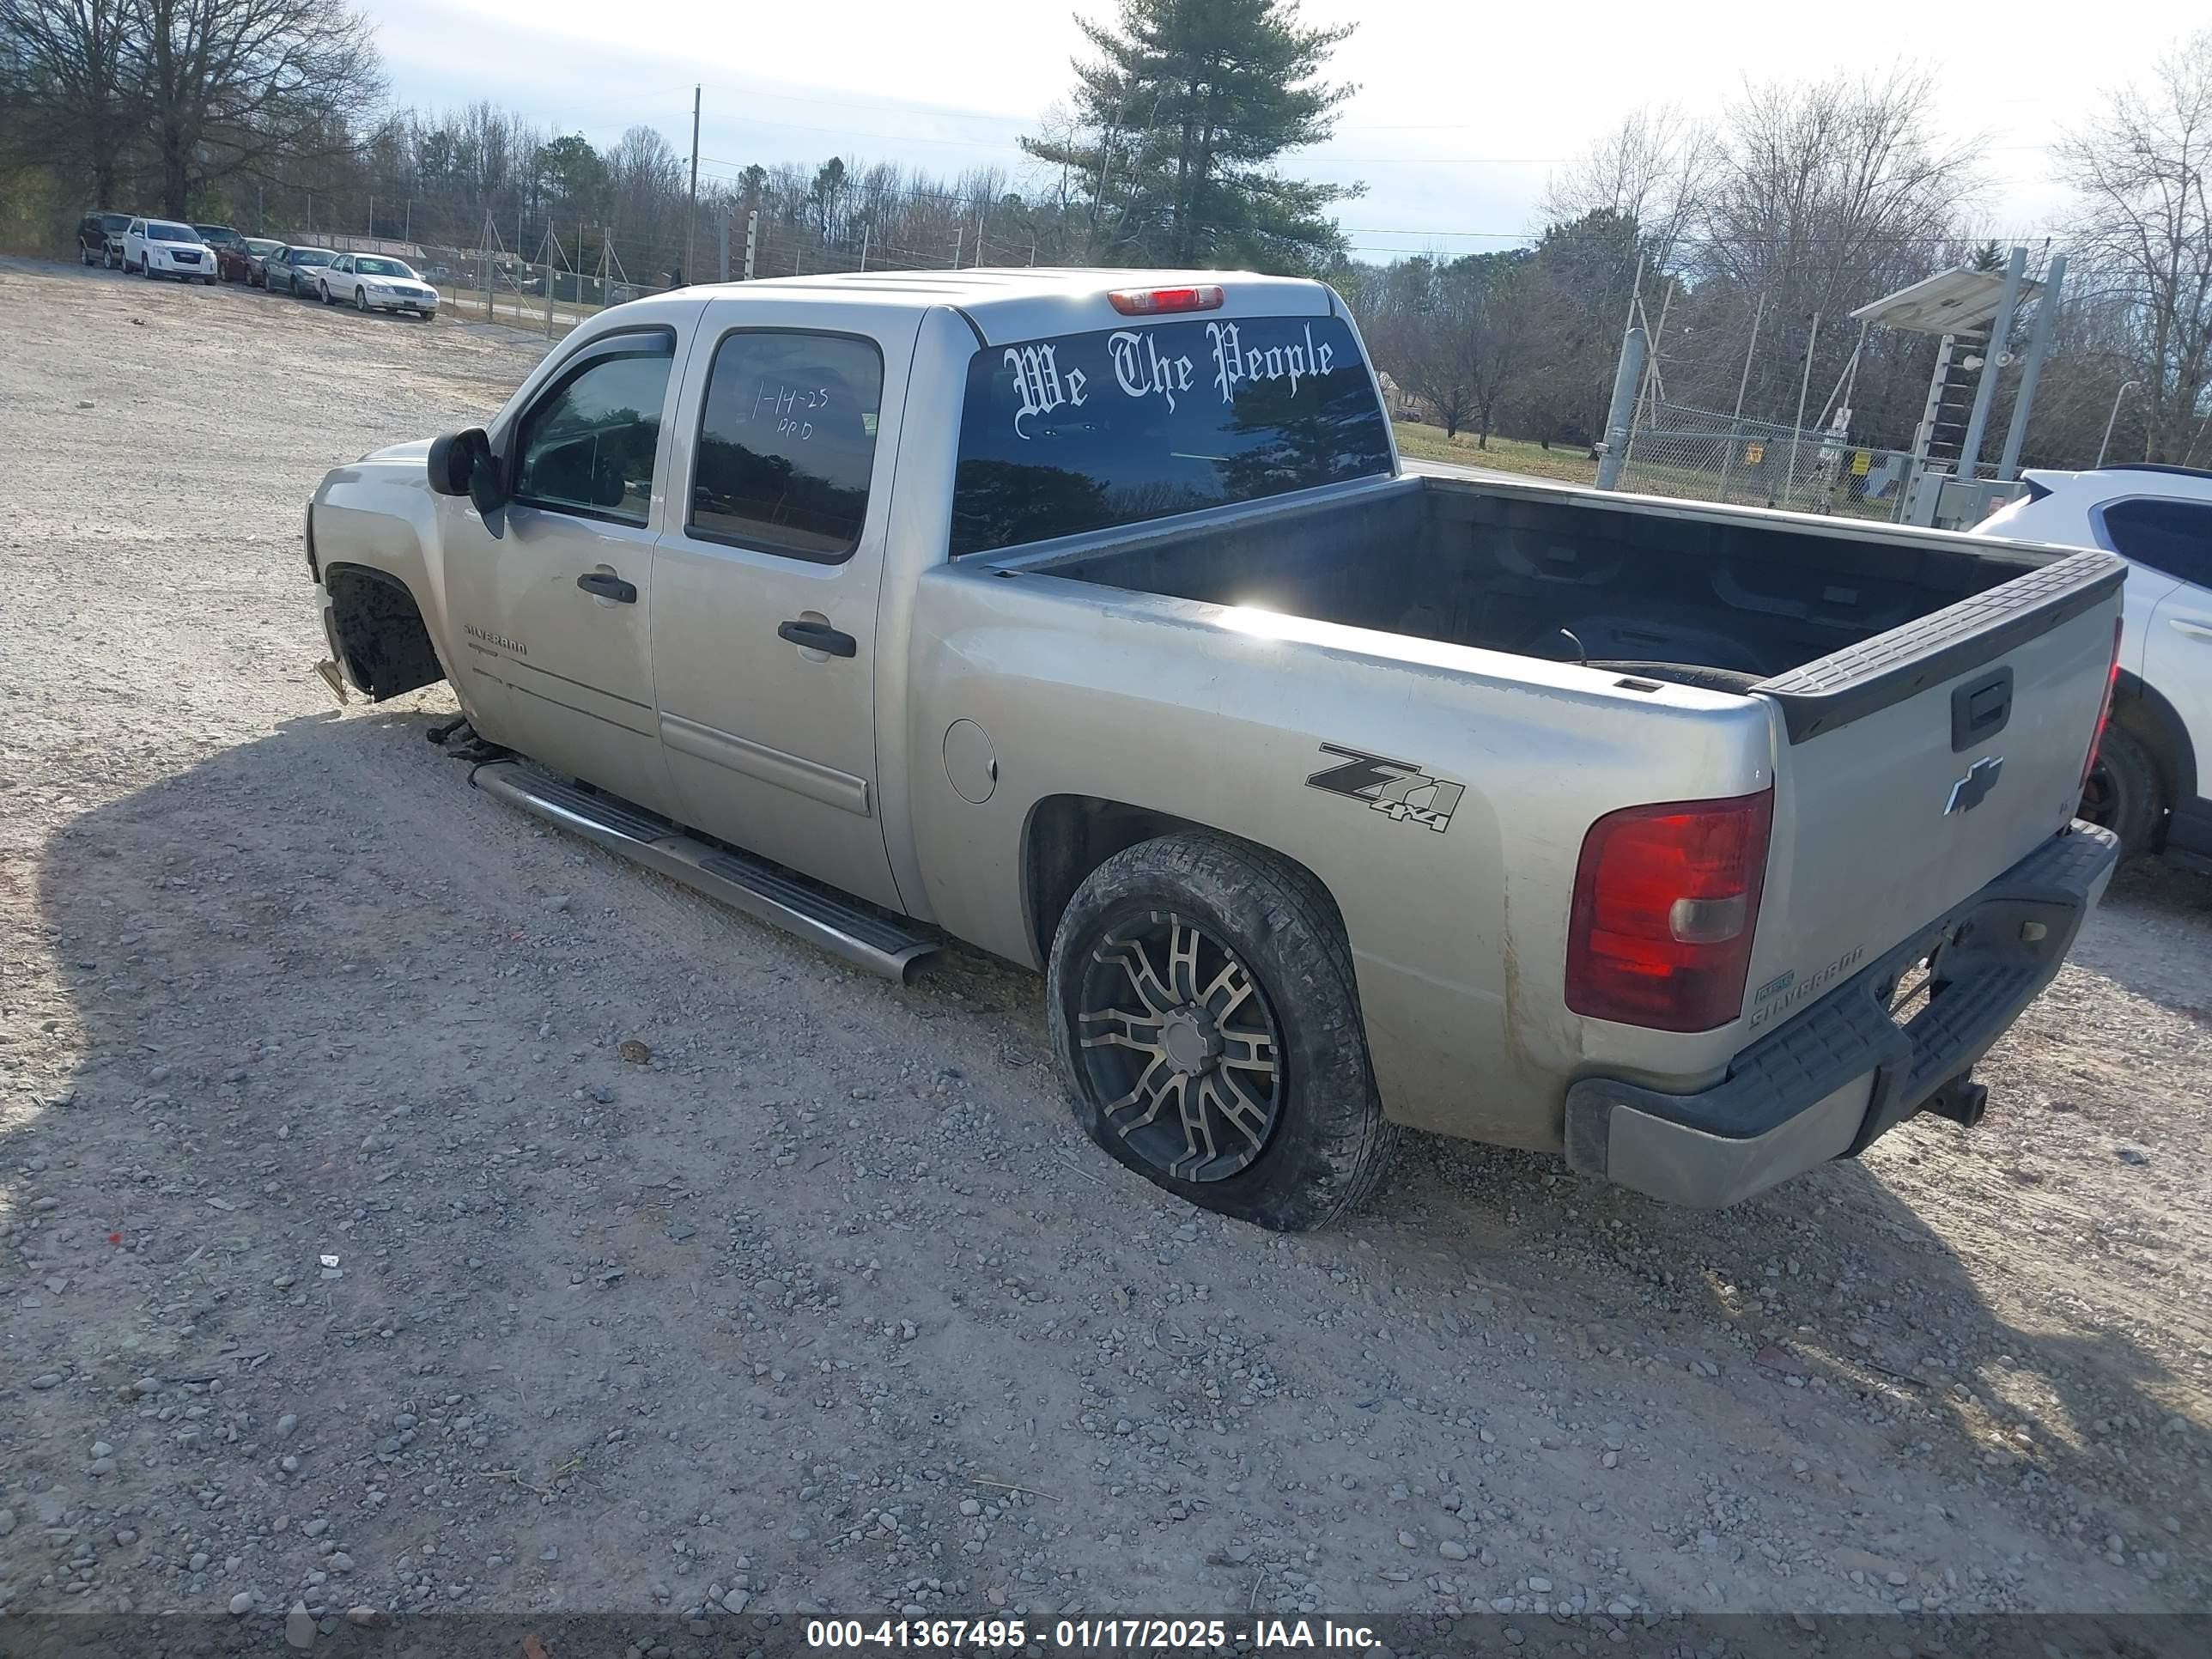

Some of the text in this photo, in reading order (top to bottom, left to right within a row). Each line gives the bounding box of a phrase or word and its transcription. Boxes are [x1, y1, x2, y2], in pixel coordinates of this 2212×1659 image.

[752, 380, 830, 420] 1-14-25
[1003, 321, 1334, 440] We The People
[463, 624, 527, 654] SILVERADO
[1304, 741, 1466, 817] Z71
[1749, 945, 1863, 1030] SILVERADO
